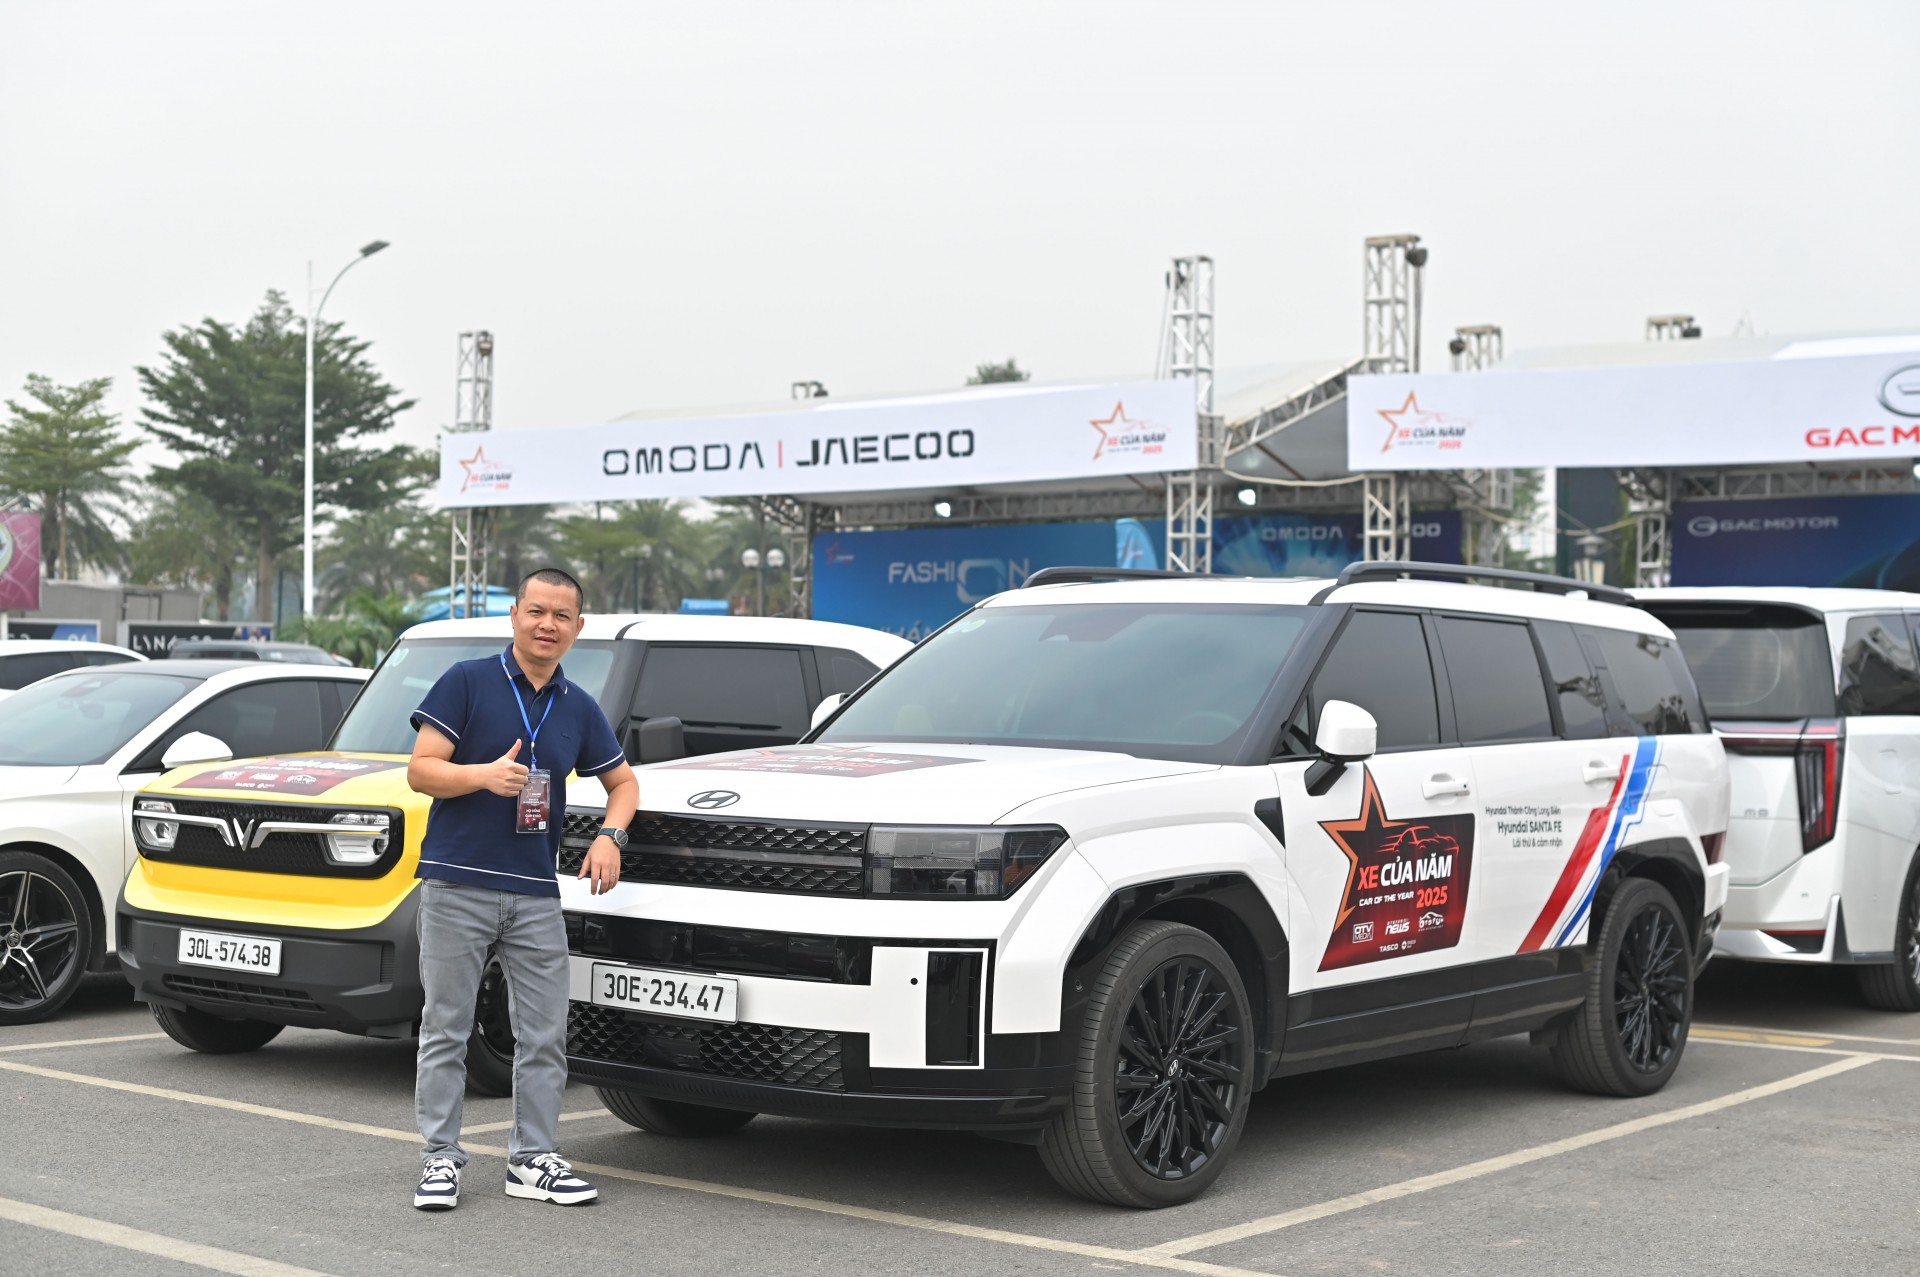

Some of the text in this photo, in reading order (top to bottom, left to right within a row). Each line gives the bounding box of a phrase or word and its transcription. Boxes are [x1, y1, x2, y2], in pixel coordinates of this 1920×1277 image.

[1805, 427, 1885, 447] GAC
[603, 429, 975, 476] OMODA JAECOO
[1261, 525, 1343, 542] OMODA
[1719, 516, 1839, 532] GAC MOTOR
[888, 557, 1029, 604] FASHION
[1485, 805, 1507, 816] Hyundai
[1498, 820, 1562, 836] Hyundai SANTA FE
[1357, 852, 1453, 891] XE CỦA NĂM
[1359, 885, 1448, 909] CAR OF THE YEAR 2025
[1354, 924, 1373, 935] OTV
[187, 937, 271, 967] 30L-574.38
[1379, 943, 1399, 953] TASCO
[604, 973, 724, 1013] 30E-234.47
